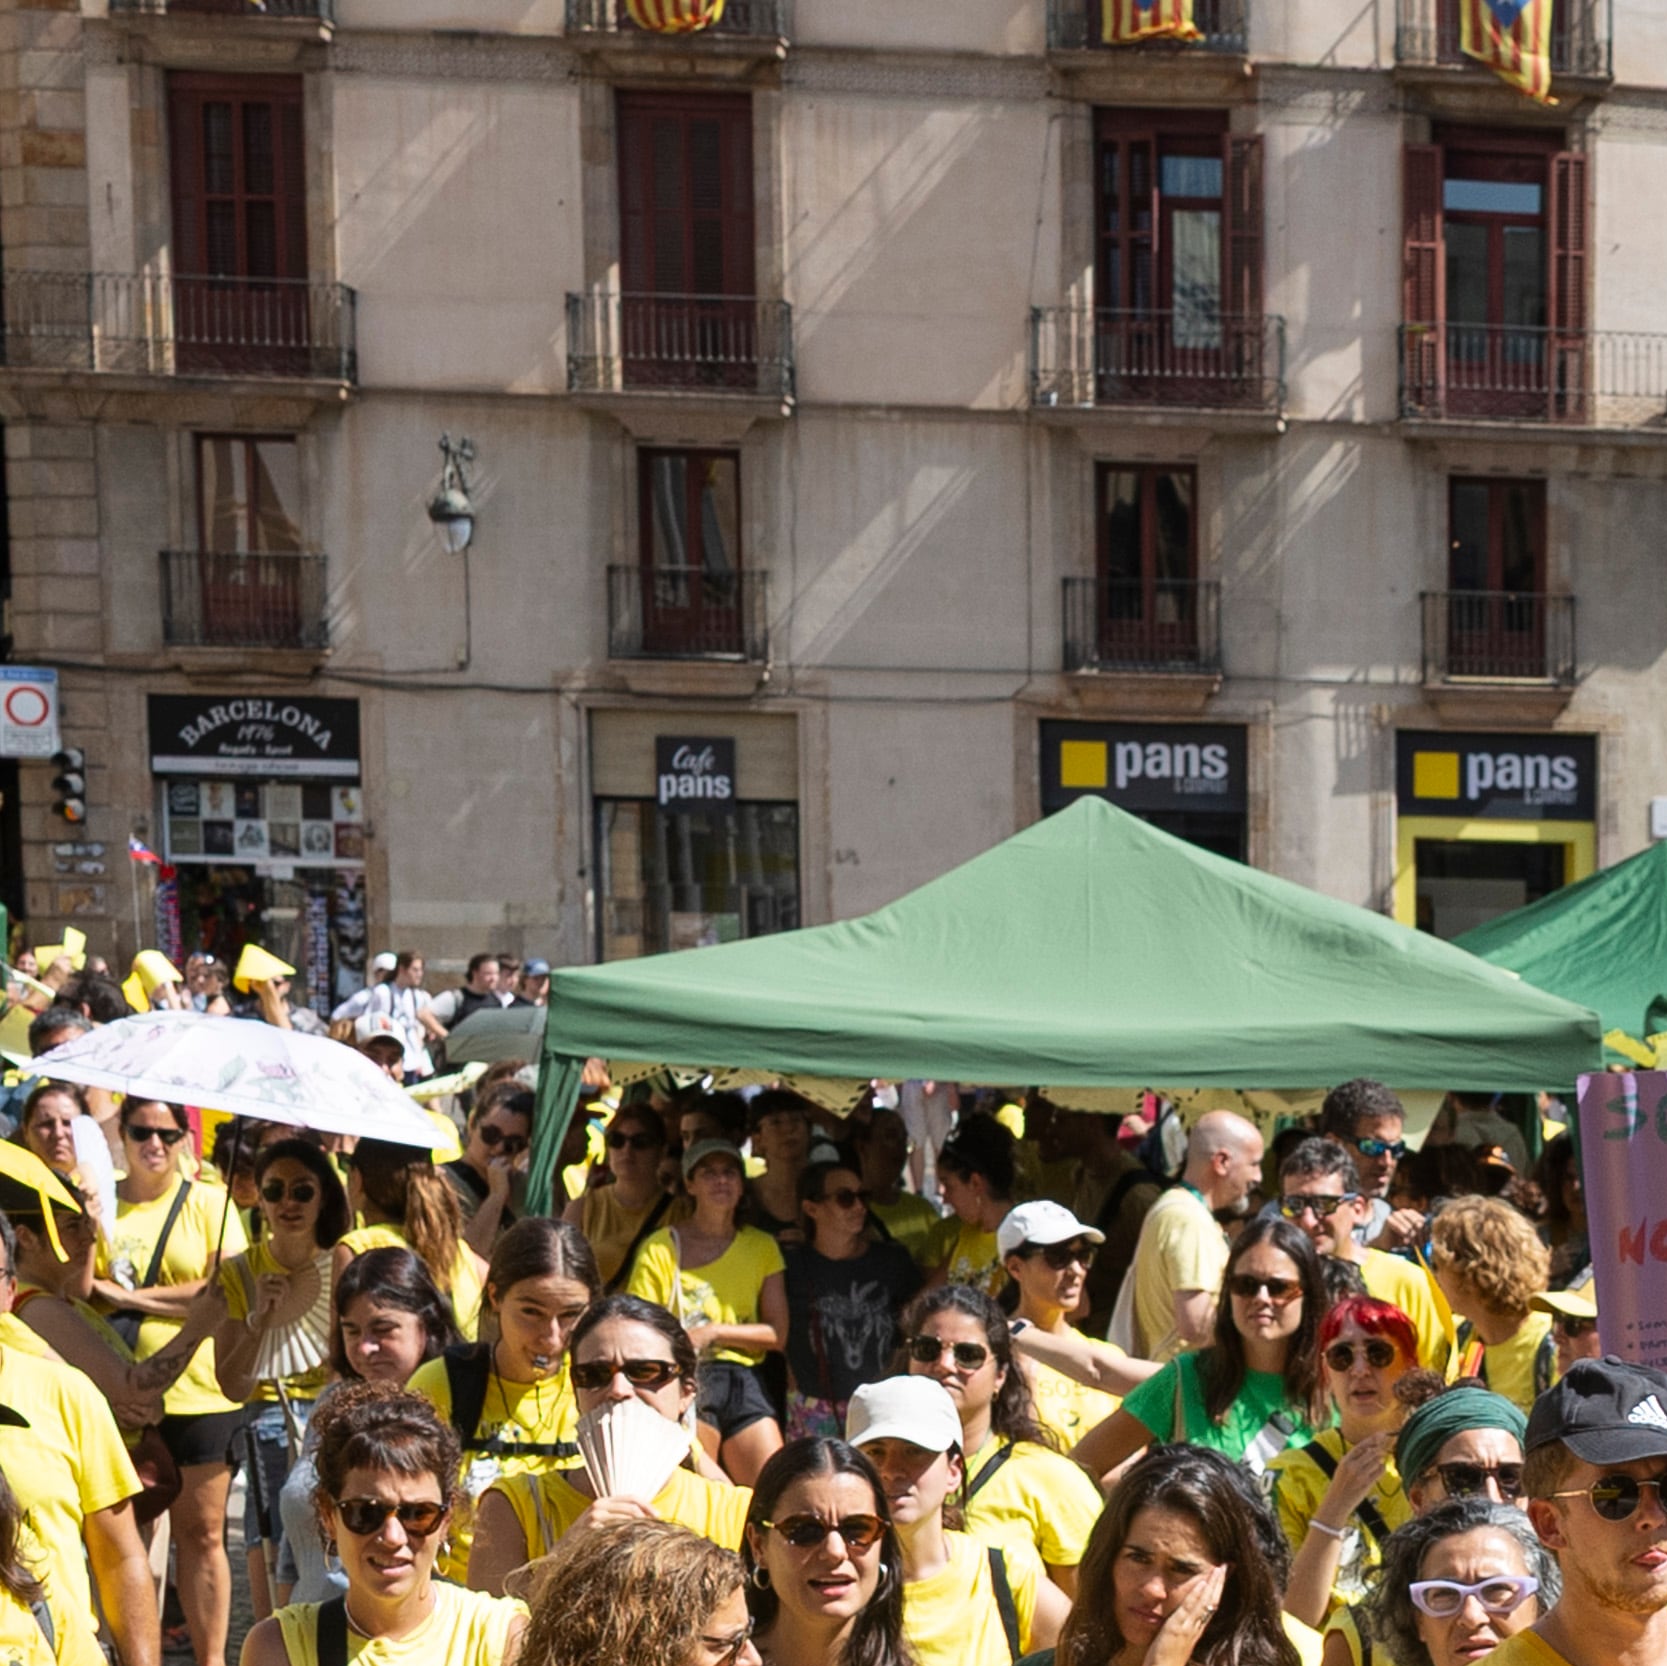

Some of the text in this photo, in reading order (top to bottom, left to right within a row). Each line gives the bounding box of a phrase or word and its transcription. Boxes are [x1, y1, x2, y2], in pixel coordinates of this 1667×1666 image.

[178, 700, 333, 750] BARCELONA
[659, 773, 731, 805] pans
[1115, 741, 1229, 789] pans
[1466, 752, 1578, 801] pans
